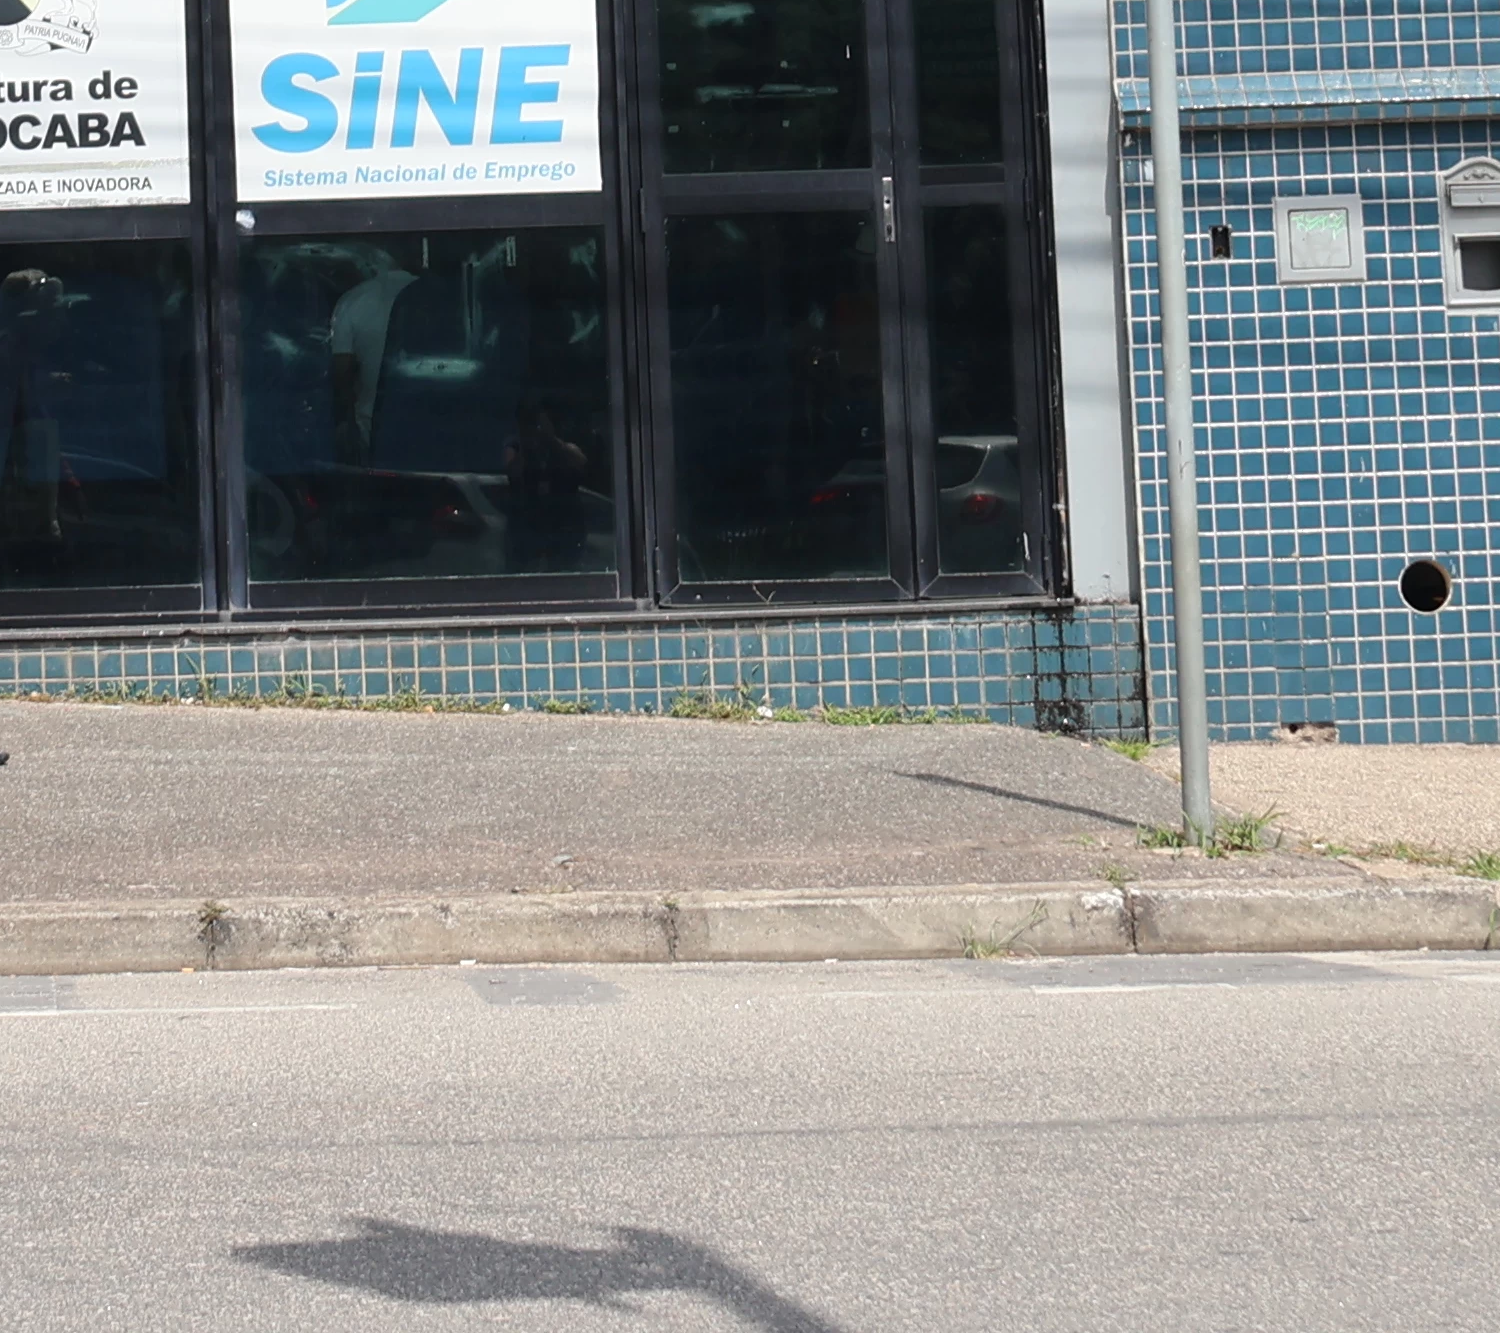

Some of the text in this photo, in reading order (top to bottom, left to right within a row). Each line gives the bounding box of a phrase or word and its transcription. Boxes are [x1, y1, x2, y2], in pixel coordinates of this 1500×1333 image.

[23, 24, 51, 38] PATRIA
[51, 29, 86, 49] PUGNAVI
[87, 69, 139, 101] de
[42, 178, 52, 194] E
[56, 174, 153, 194] INOVADORA
[263, 157, 577, 189] Sistema Nacional de Emprego
